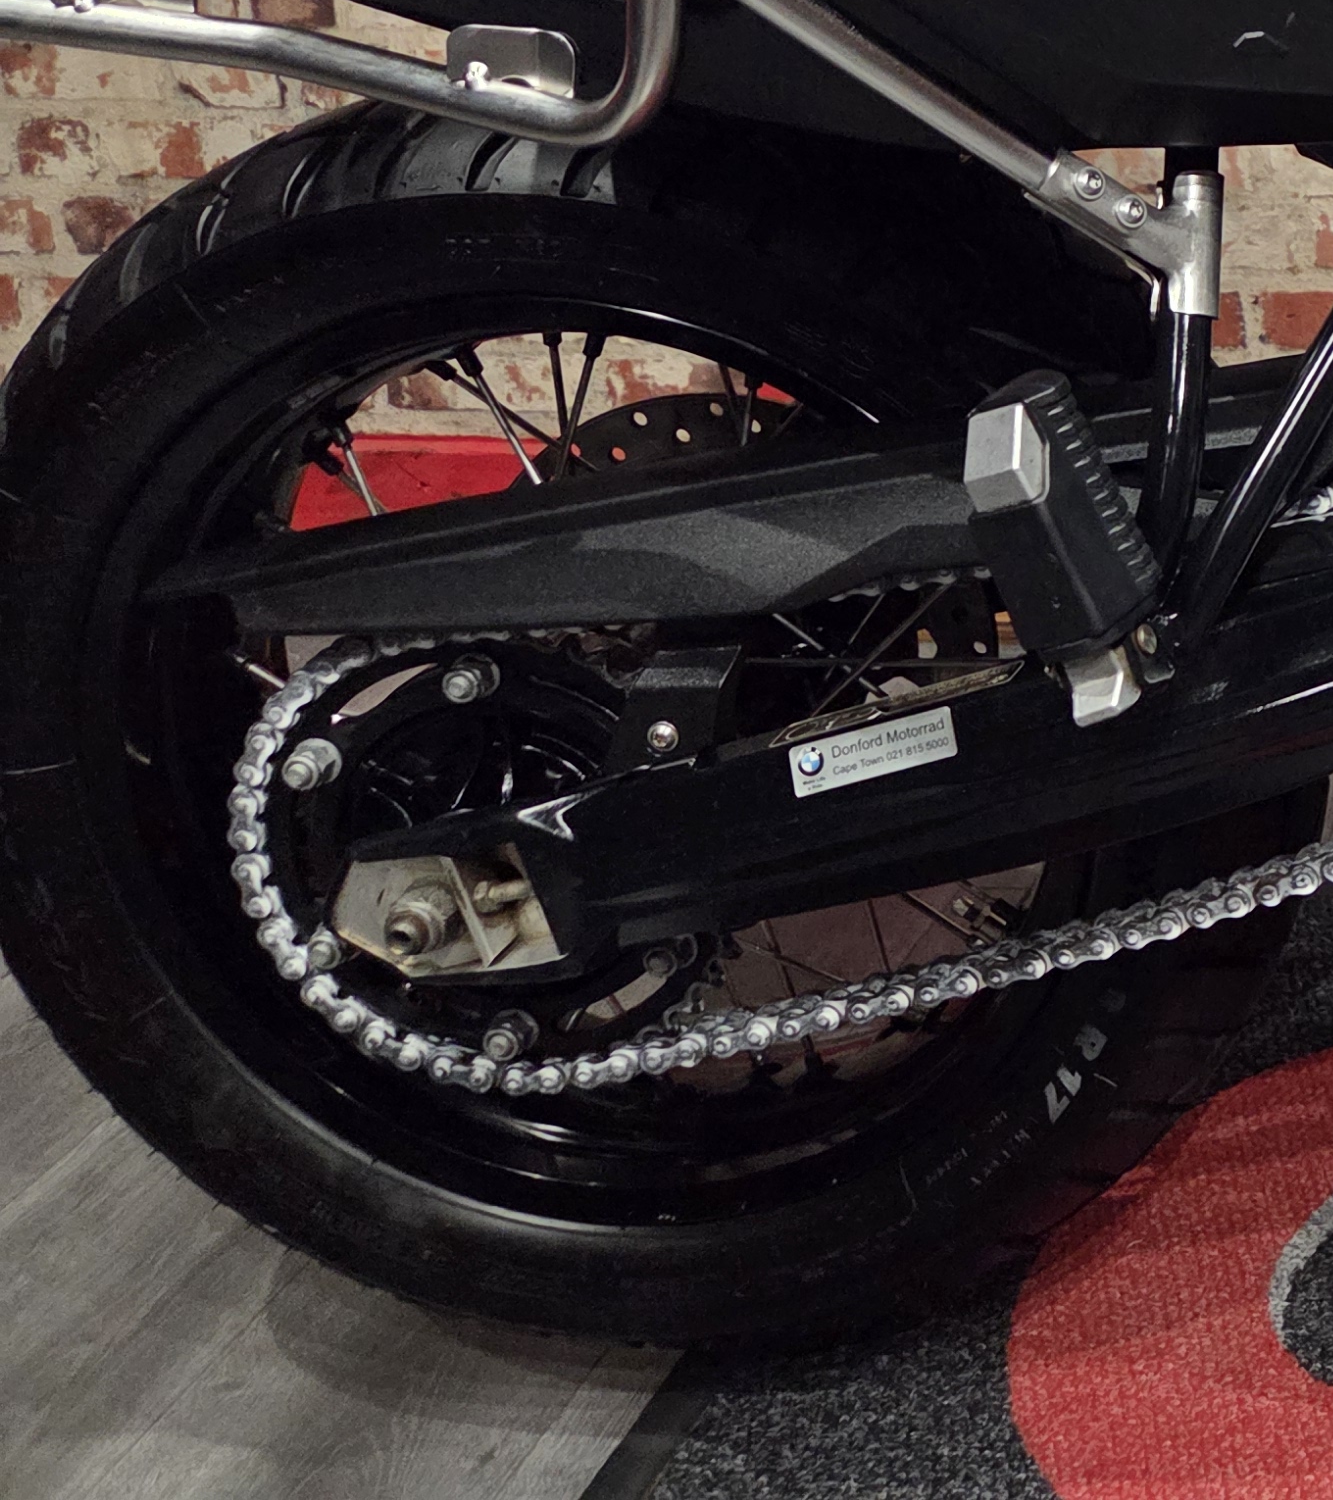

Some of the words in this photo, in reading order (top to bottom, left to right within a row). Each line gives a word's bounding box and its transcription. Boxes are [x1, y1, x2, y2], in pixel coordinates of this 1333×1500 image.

[831, 734, 883, 759] Donford
[886, 718, 945, 744] Motorrad
[832, 763, 857, 776] Cape
[860, 755, 884, 769] Town
[886, 749, 903, 762] 021
[905, 743, 924, 757] 815
[926, 736, 949, 752] 5000
[1044, 1066, 1082, 1125] 17
